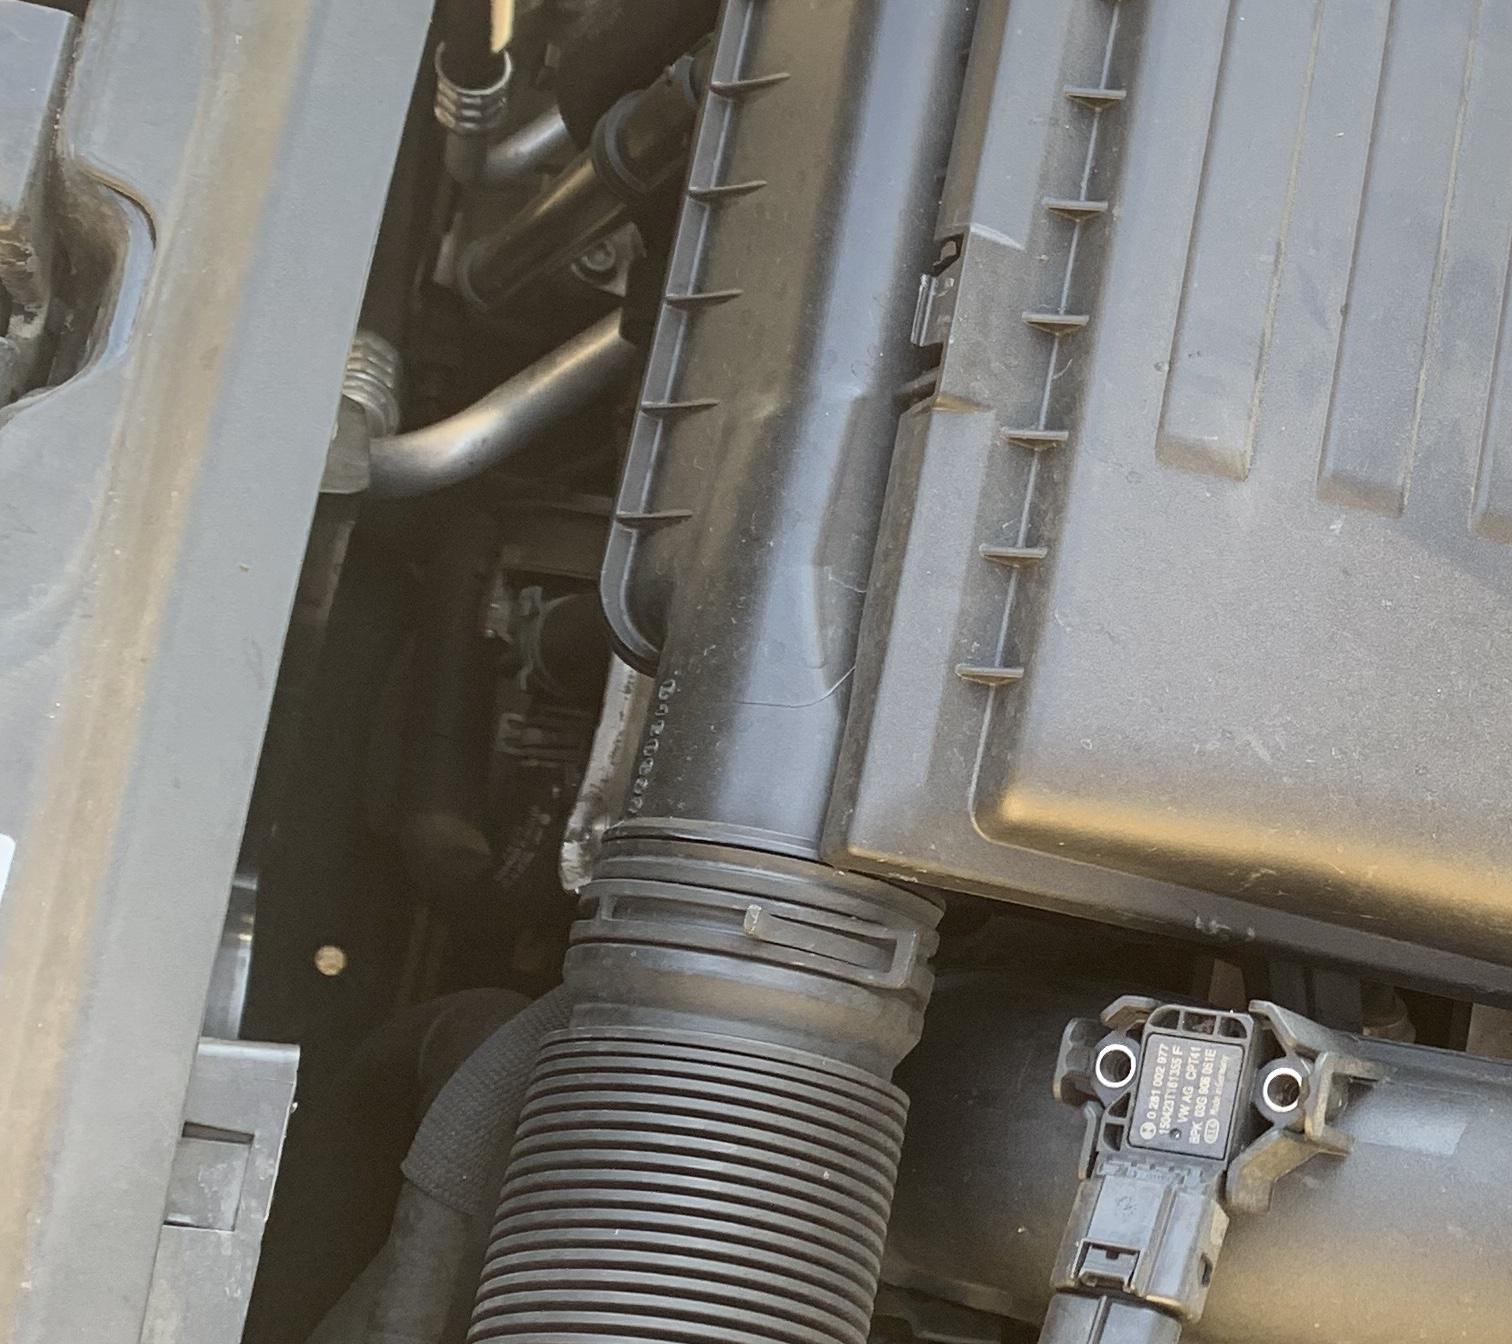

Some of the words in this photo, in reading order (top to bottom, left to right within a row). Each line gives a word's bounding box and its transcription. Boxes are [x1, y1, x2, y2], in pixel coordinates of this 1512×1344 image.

[1156, 1043, 1169, 1063] 977
[1172, 1045, 1184, 1055] F
[1185, 1046, 1201, 1080] CPT41
[1152, 1065, 1165, 1087] 002
[1148, 1089, 1161, 1109] 281
[1181, 1085, 1194, 1103] AG
[1147, 1111, 1156, 1119] 0
[1177, 1103, 1190, 1122] VW
